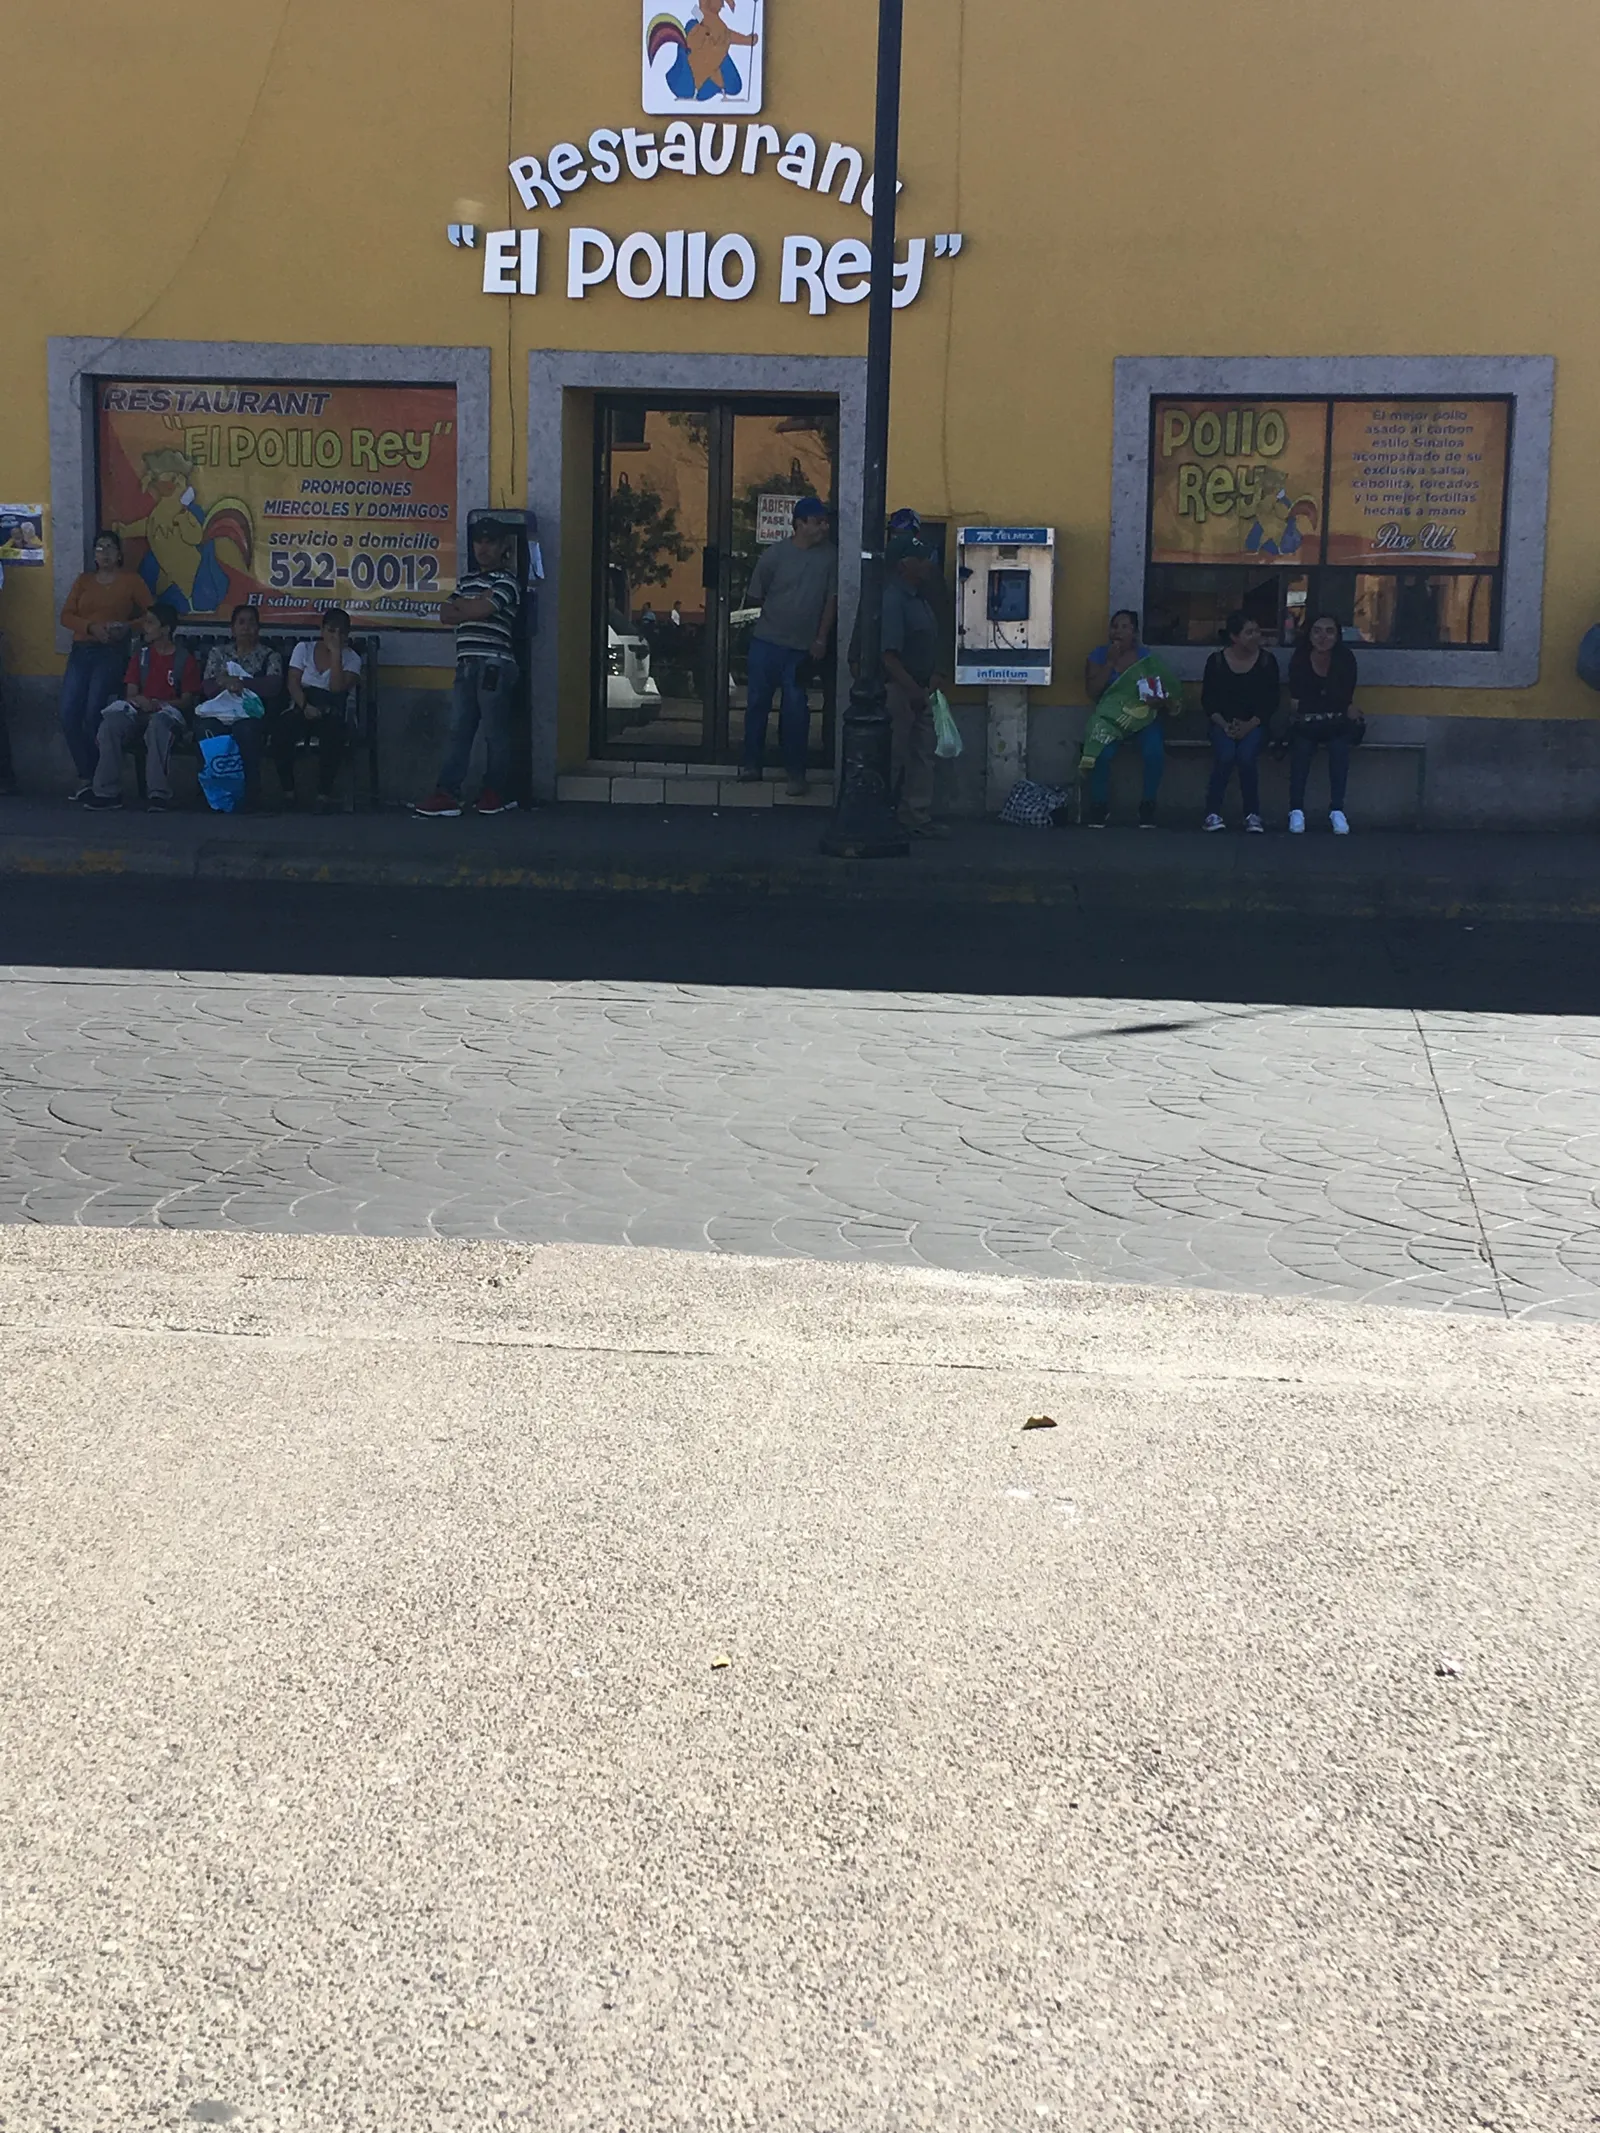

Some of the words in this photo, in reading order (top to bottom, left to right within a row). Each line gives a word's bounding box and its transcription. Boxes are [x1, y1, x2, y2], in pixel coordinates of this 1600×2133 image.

[567, 227, 756, 300] Pollo
[103, 387, 331, 416] RESTAURANT
[1373, 410, 1385, 420] El
[1390, 411, 1428, 422] mejor
[1433, 410, 1468, 422] pollo
[1162, 408, 1288, 457] Pollo
[1365, 425, 1406, 435] asado
[1410, 425, 1422, 434] al
[228, 427, 342, 468] Pollo
[1372, 438, 1409, 448] estilo
[1413, 438, 1465, 448] Sinaloa
[1445, 452, 1461, 461] de
[1467, 453, 1482, 461] su
[1364, 466, 1425, 476] exclusiva
[300, 479, 412, 496] PROMOCIONES
[1178, 464, 1265, 523] Rey
[1354, 494, 1362, 504] y
[1383, 493, 1421, 504] mejor
[264, 500, 349, 517] MIERCOLES
[354, 503, 363, 517] Y
[366, 503, 449, 519] DOMINGOS
[762, 498, 796, 514] ABIERT
[1364, 506, 1411, 516] hechas
[1416, 507, 1424, 516] a
[762, 516, 785, 526] PASE
[269, 530, 339, 548] servicio
[342, 535, 354, 548] a
[359, 532, 440, 550] domicilio
[761, 528, 789, 540] EMPU
[995, 531, 1035, 540] TELMEX
[269, 551, 440, 592] 522-0012
[247, 594, 263, 607] El
[268, 595, 309, 608] sabor
[313, 599, 340, 614] que
[345, 600, 370, 610] nos
[977, 669, 1029, 678] infinitum
